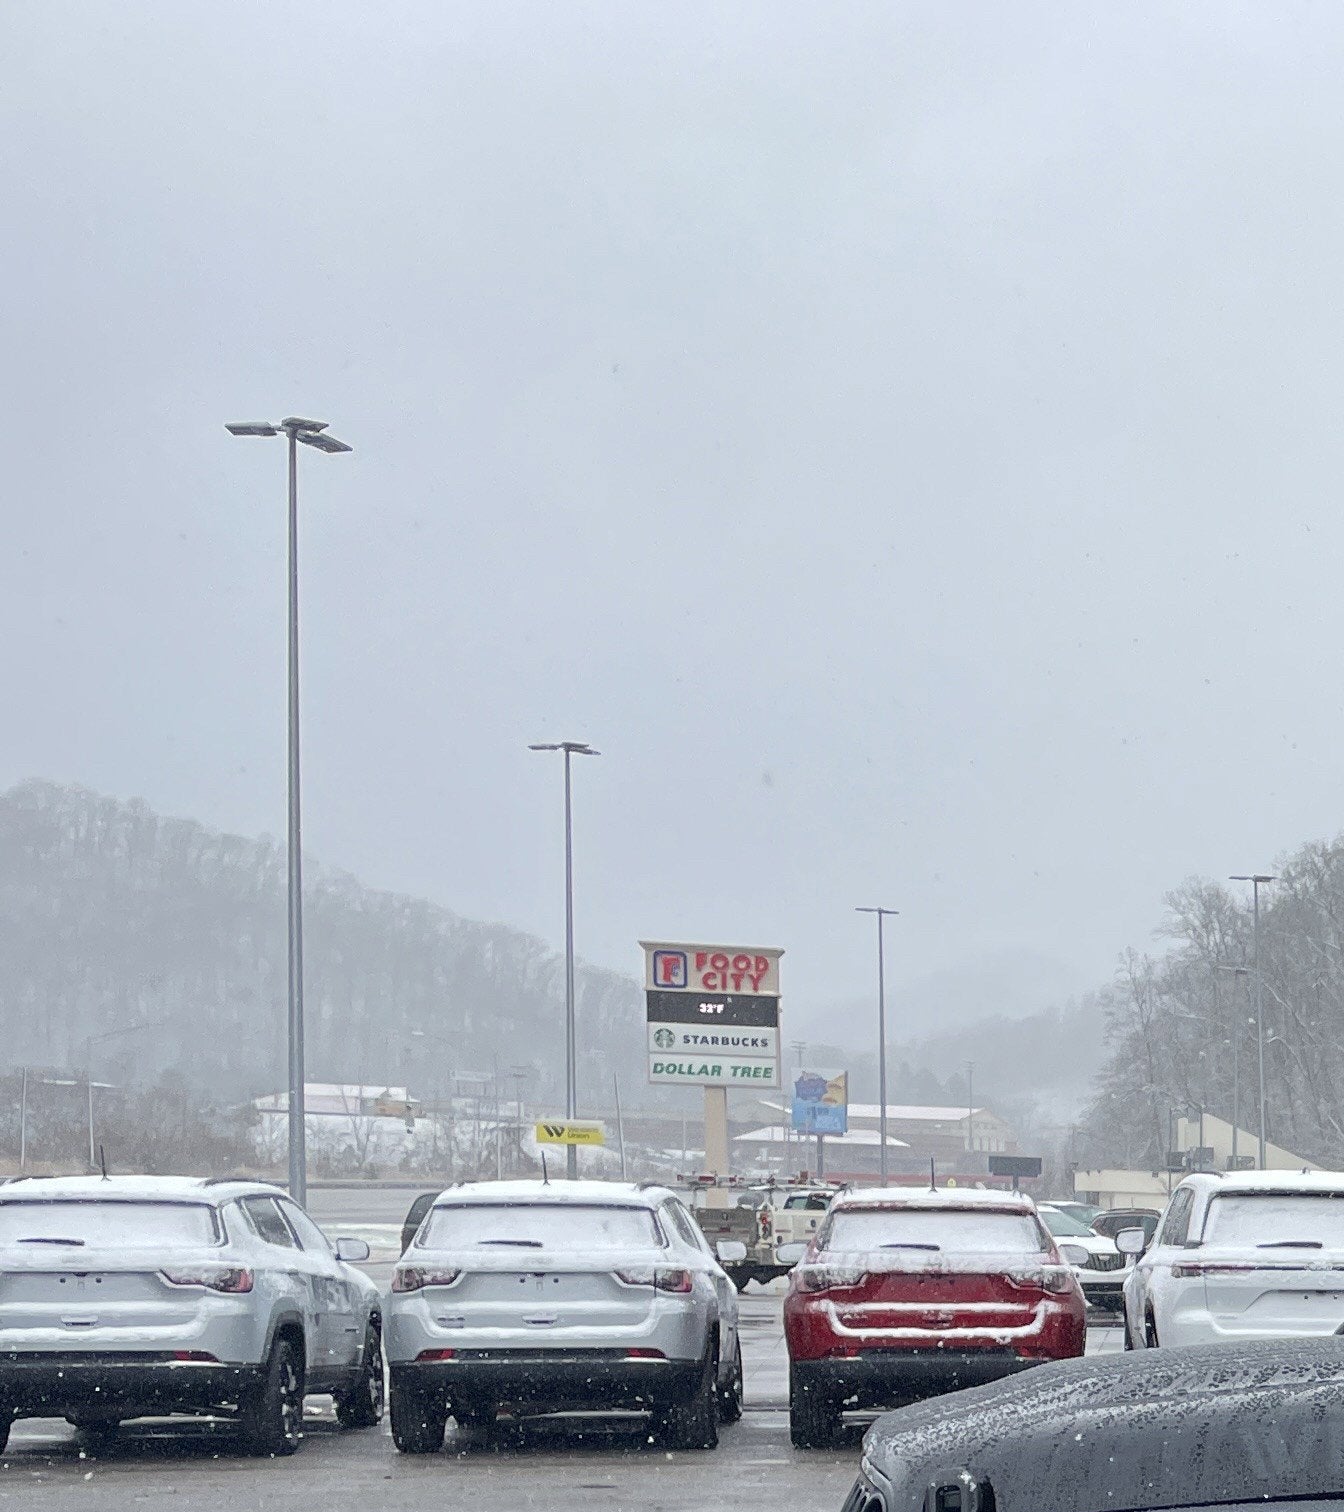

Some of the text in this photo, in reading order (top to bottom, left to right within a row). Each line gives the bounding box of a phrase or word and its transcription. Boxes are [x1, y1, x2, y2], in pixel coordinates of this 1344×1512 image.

[695, 952, 769, 974] FOOD
[702, 972, 763, 992] CITY
[682, 1034, 769, 1047] STARBUCKS
[652, 1062, 773, 1079] DOLLAR TREE
